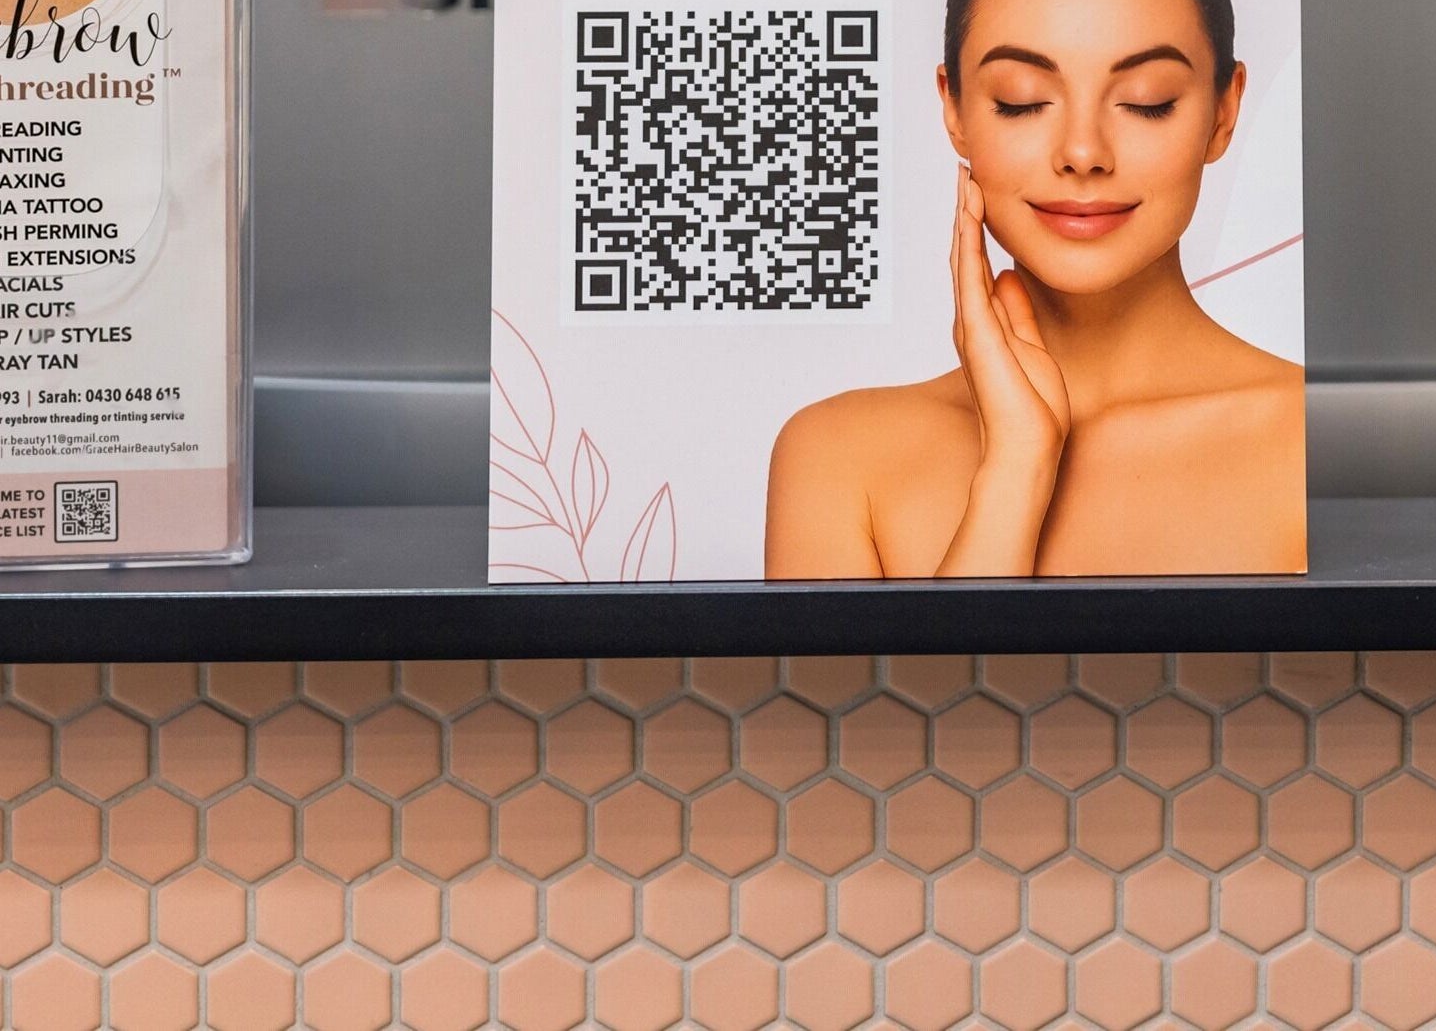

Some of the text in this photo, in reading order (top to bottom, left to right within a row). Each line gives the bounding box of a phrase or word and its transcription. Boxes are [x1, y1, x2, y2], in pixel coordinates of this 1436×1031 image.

[0, 120, 82, 138] EADING
[23, 198, 103, 214] TATTOO
[0, 223, 119, 241] H PERMING
[7, 249, 136, 267] EXTENSIONS
[0, 302, 76, 319] IR CUTS
[29, 328, 56, 344] UP
[61, 326, 133, 343] STYLES
[37, 353, 79, 369] TAN
[0, 391, 20, 404] 93
[38, 389, 82, 404] Sarah:
[86, 388, 122, 402] 0430
[125, 387, 152, 401] 648
[156, 386, 181, 400] 615
[5, 414, 48, 427] eyebrow
[49, 412, 99, 425] threading
[101, 414, 112, 422] or
[113, 411, 148, 424] tinting
[150, 410, 185, 421] service
[11, 442, 199, 457] facebook.com/GraceHairBeautySalon
[26, 489, 45, 501] TO
[0, 507, 45, 520] ATEST
[16, 525, 45, 537] LIST
